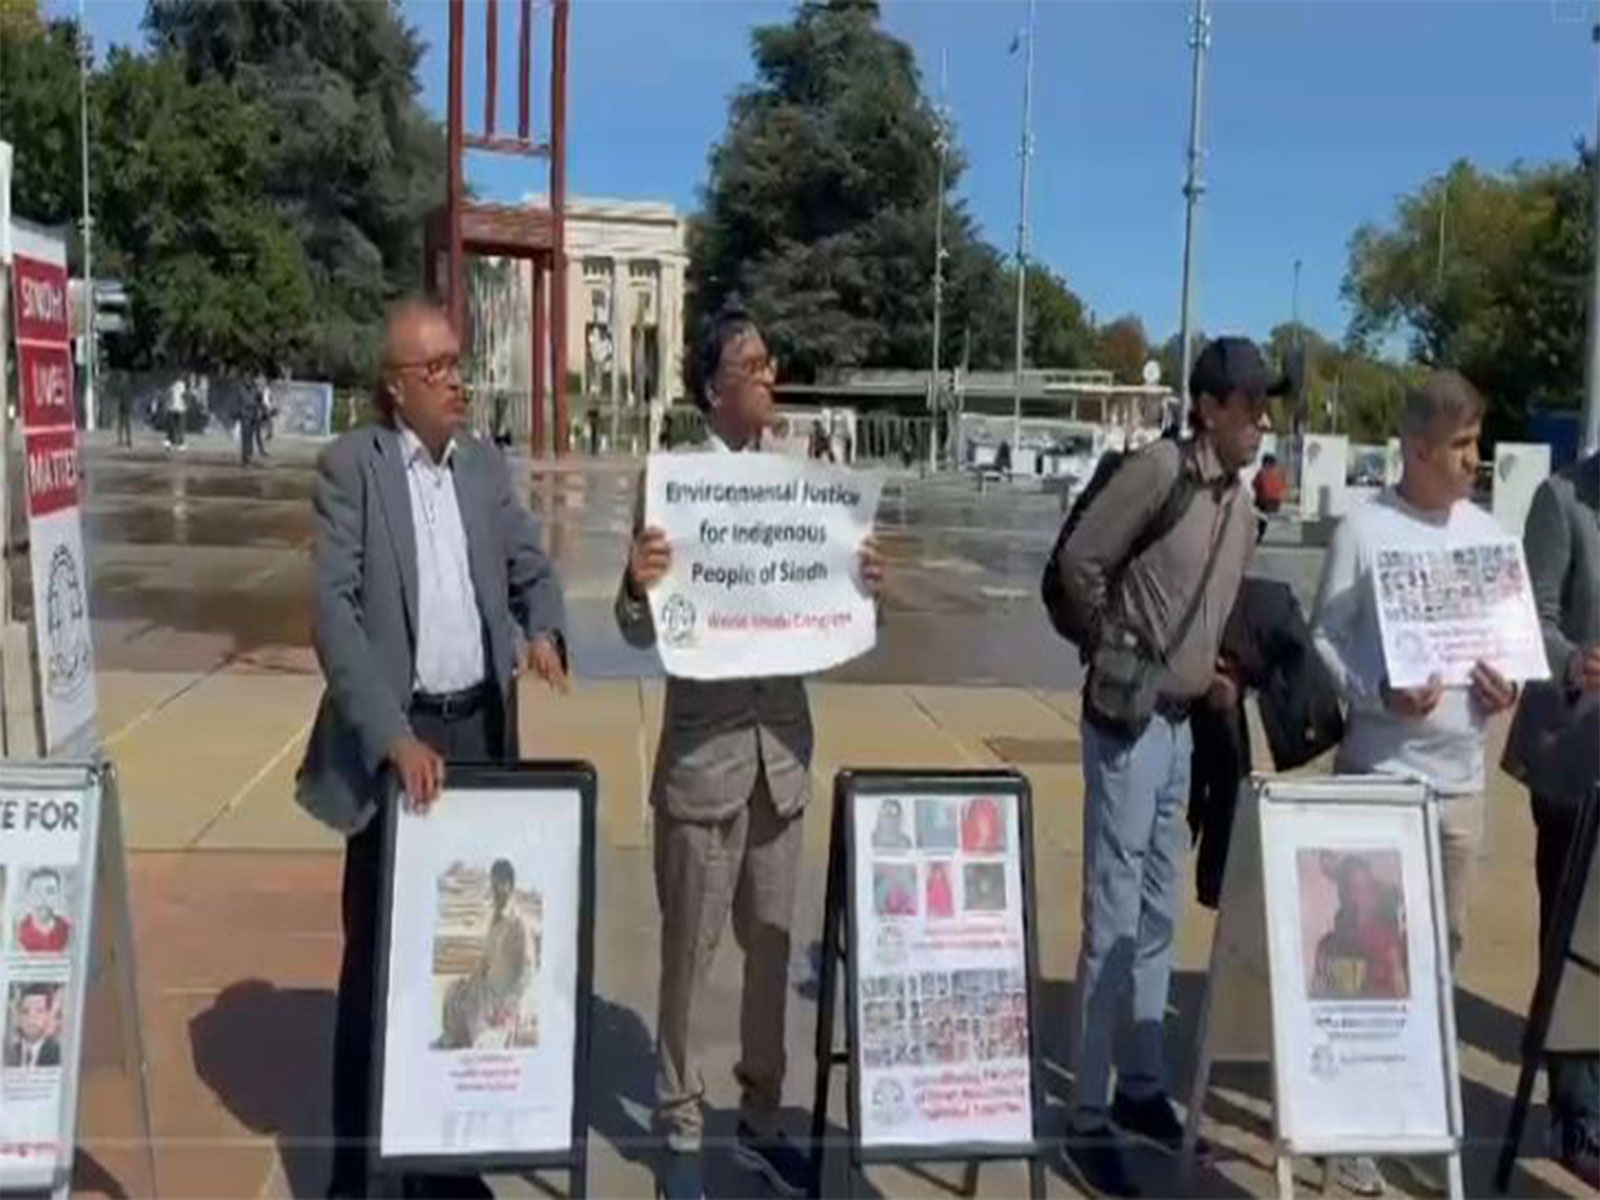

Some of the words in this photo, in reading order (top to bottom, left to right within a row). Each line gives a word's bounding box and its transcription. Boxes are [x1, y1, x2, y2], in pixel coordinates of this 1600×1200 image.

[666, 479, 798, 505] Environmental
[802, 482, 861, 506] Justice
[699, 518, 729, 543] for
[733, 520, 827, 546] Indigenous
[692, 562, 755, 589] People
[759, 561, 776, 583] of
[779, 559, 828, 582] Sindh
[25, 798, 79, 831] FOR
